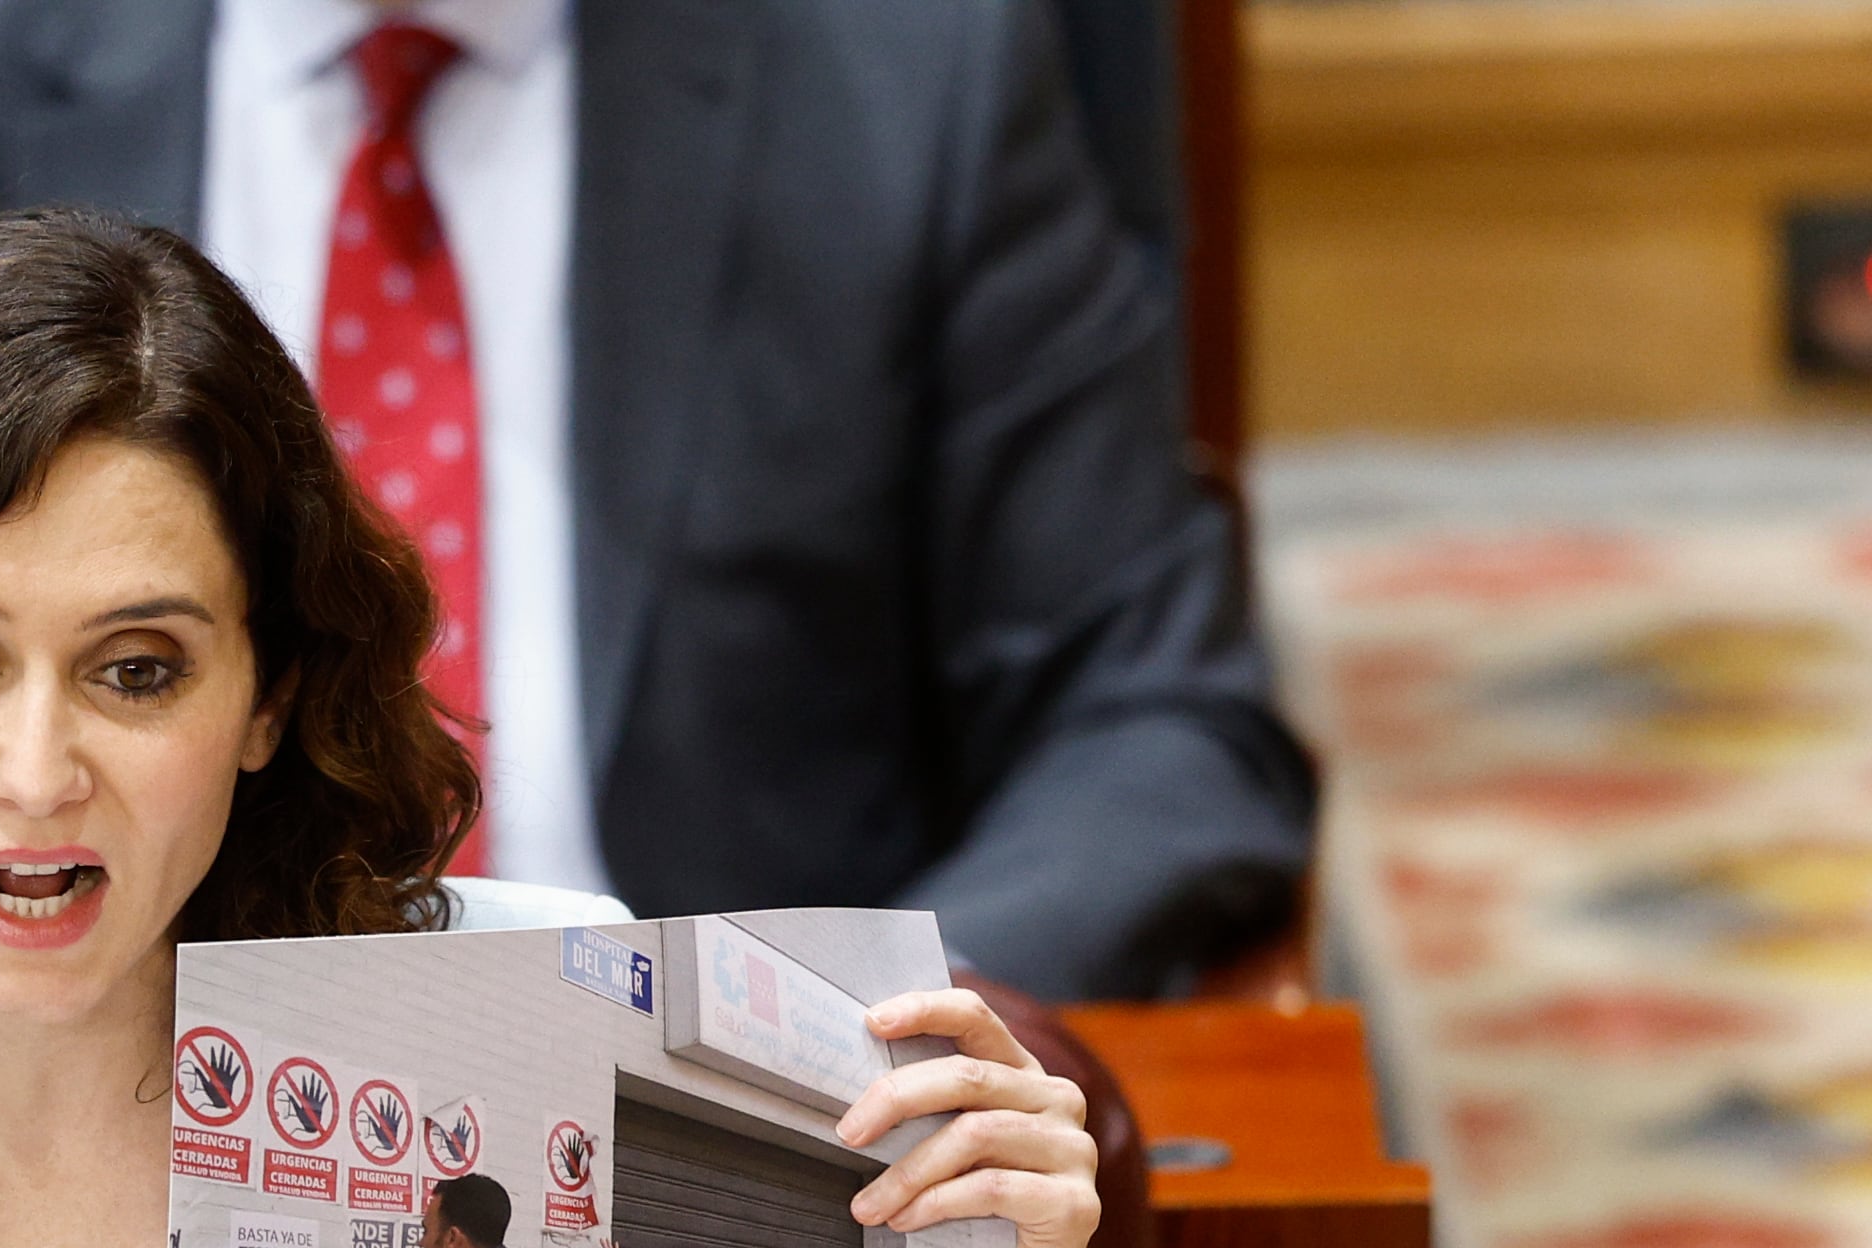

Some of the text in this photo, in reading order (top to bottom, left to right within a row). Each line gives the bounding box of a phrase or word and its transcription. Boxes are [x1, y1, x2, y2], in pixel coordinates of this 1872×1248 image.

[573, 941, 602, 978] DEL
[611, 960, 643, 998] MAR
[174, 1129, 245, 1151] URGENCIAS
[173, 1149, 238, 1170] CERRADAS
[271, 1153, 333, 1172] URGENCIAS
[183, 1165, 208, 1177] SALUD
[209, 1169, 242, 1181] VENDIDA
[270, 1172, 327, 1190] CERRADAS
[355, 1170, 409, 1186] URGENCIAS
[279, 1186, 301, 1196] SALUD
[354, 1188, 404, 1202] CERRADAS
[549, 1195, 589, 1208] URGENCIAS
[238, 1227, 312, 1247] BASTA YA DE
